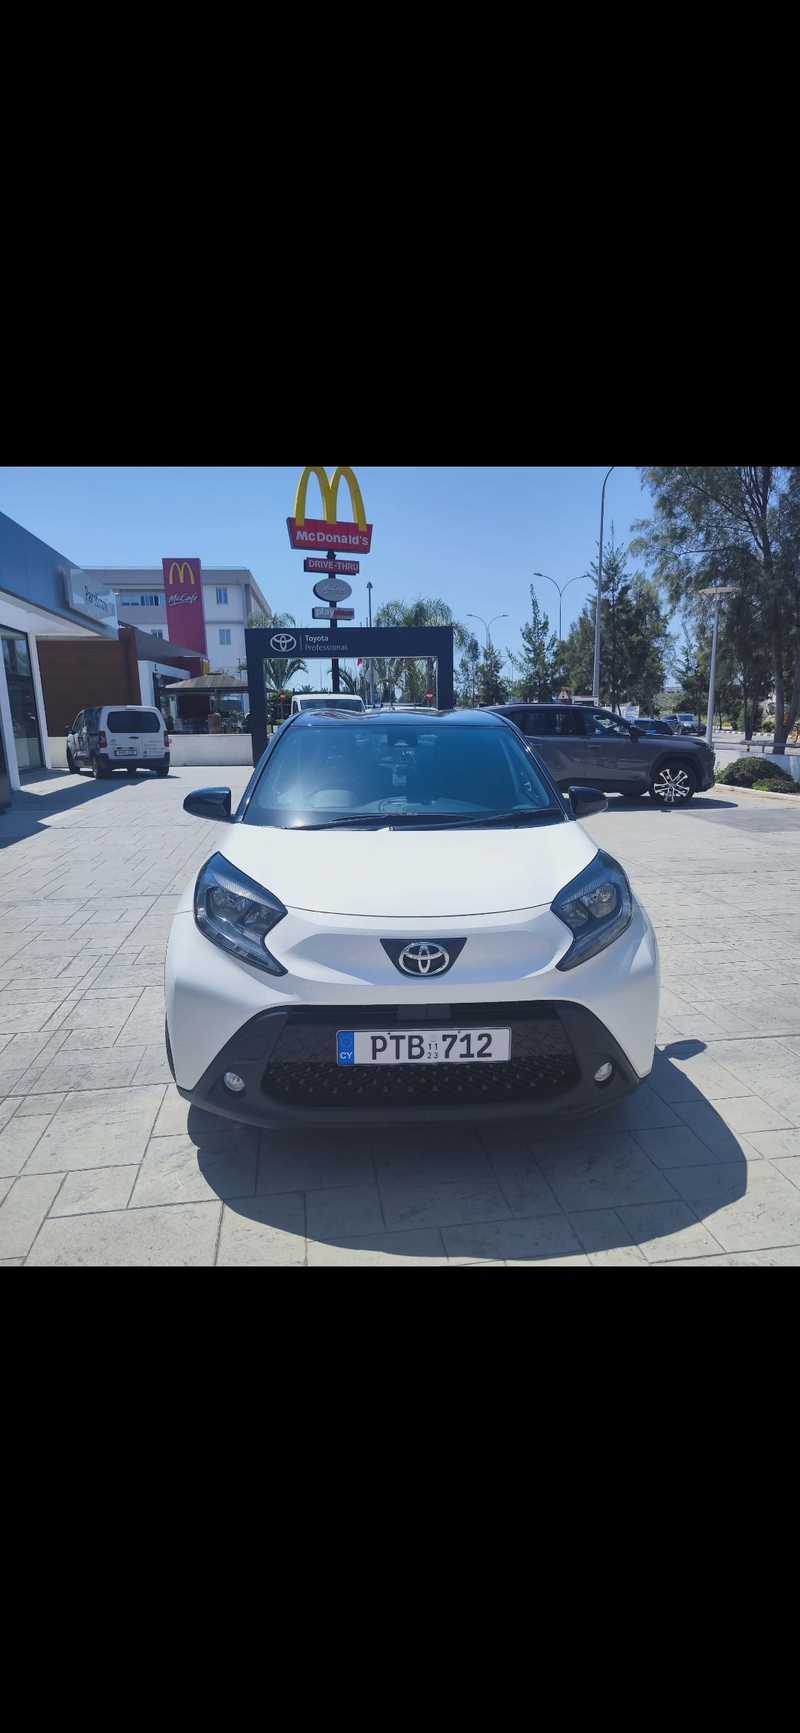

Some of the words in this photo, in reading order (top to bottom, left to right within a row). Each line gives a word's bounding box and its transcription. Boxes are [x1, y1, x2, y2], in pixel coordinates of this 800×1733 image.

[296, 531, 369, 546] McDonald's
[308, 559, 359, 572] DRIVE-THRU
[304, 634, 329, 644] Toyota
[304, 644, 349, 653] Professional
[370, 1034, 425, 1061] PTB
[441, 1032, 493, 1060] 712
[339, 1051, 353, 1060] CY
